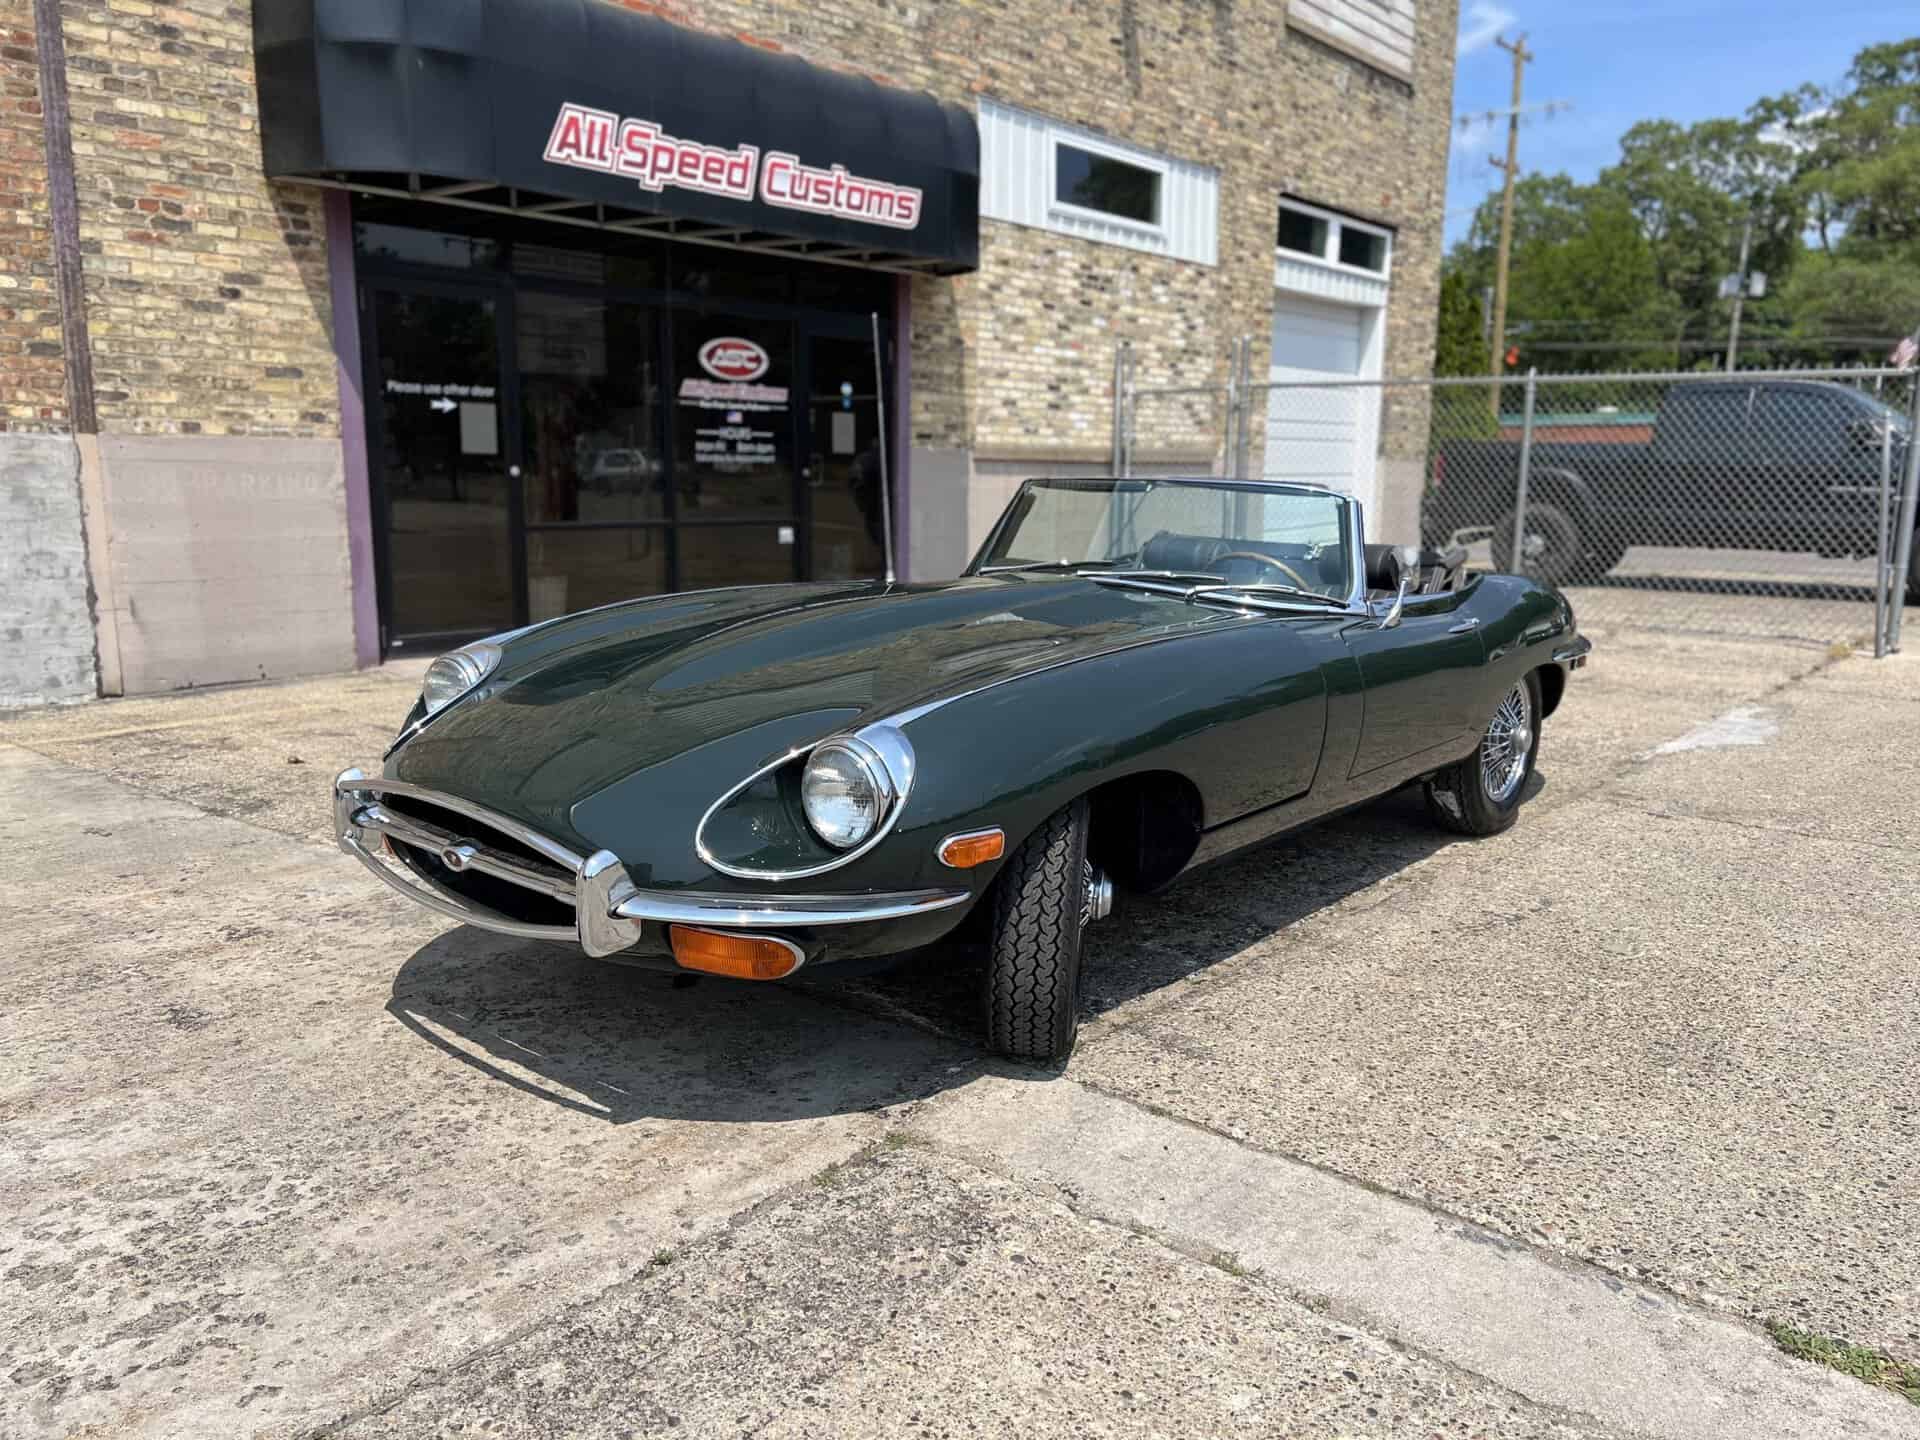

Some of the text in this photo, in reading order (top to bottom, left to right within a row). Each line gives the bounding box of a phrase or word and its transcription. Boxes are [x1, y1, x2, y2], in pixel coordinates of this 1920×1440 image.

[549, 107, 918, 225] All Speed Customs
